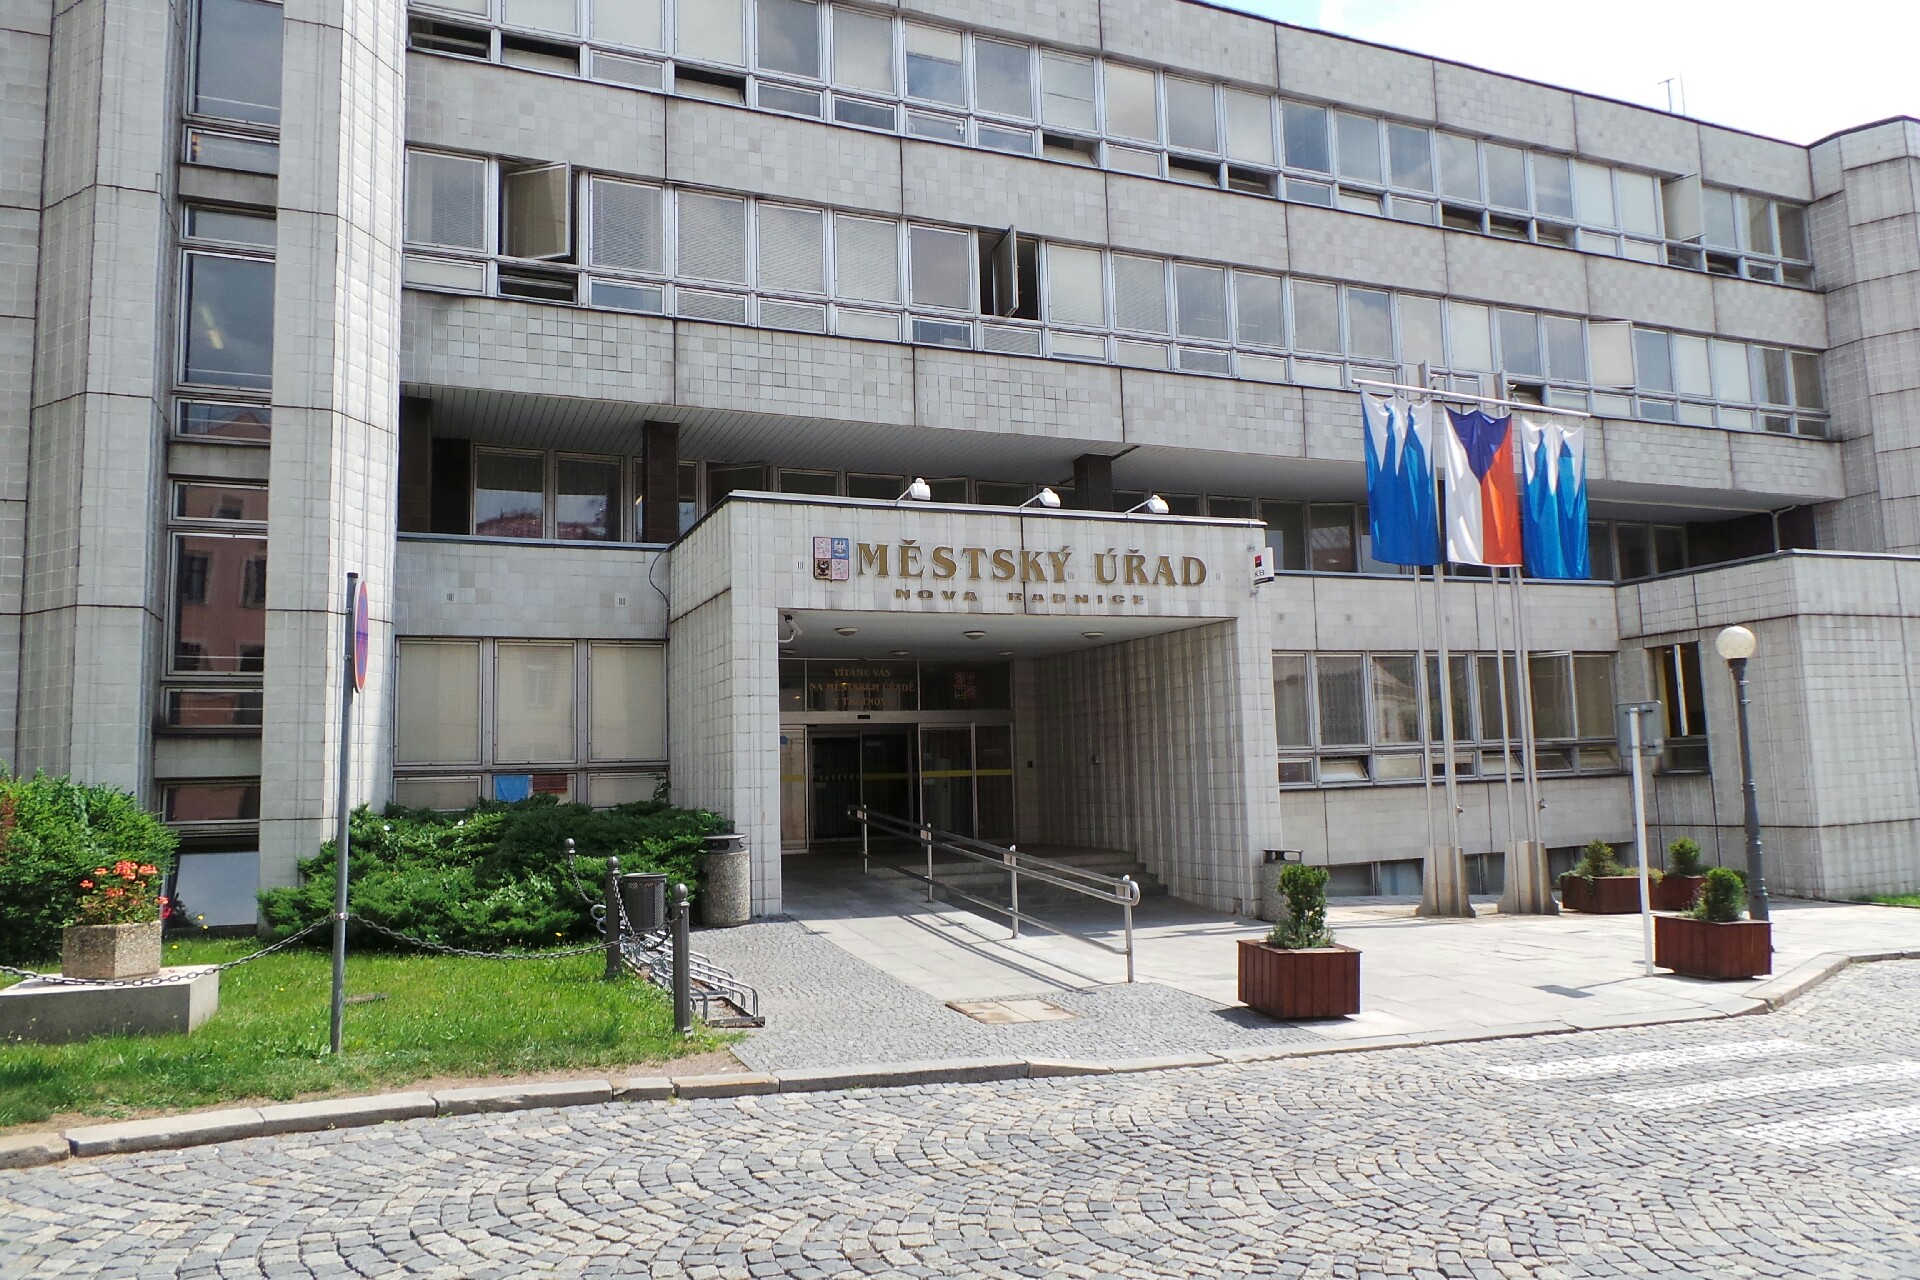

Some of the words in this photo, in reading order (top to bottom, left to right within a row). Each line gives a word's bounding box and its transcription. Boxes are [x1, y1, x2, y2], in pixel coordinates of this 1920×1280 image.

[856, 539, 1072, 582] MĚSTSKÝ
[1094, 547, 1207, 586] ÚŘAD
[895, 589, 979, 602] NOVA
[1008, 592, 1146, 605] RADNICE
[833, 665, 870, 677] VÍTÁME
[873, 665, 892, 677] VÁS
[809, 683, 823, 691] NA
